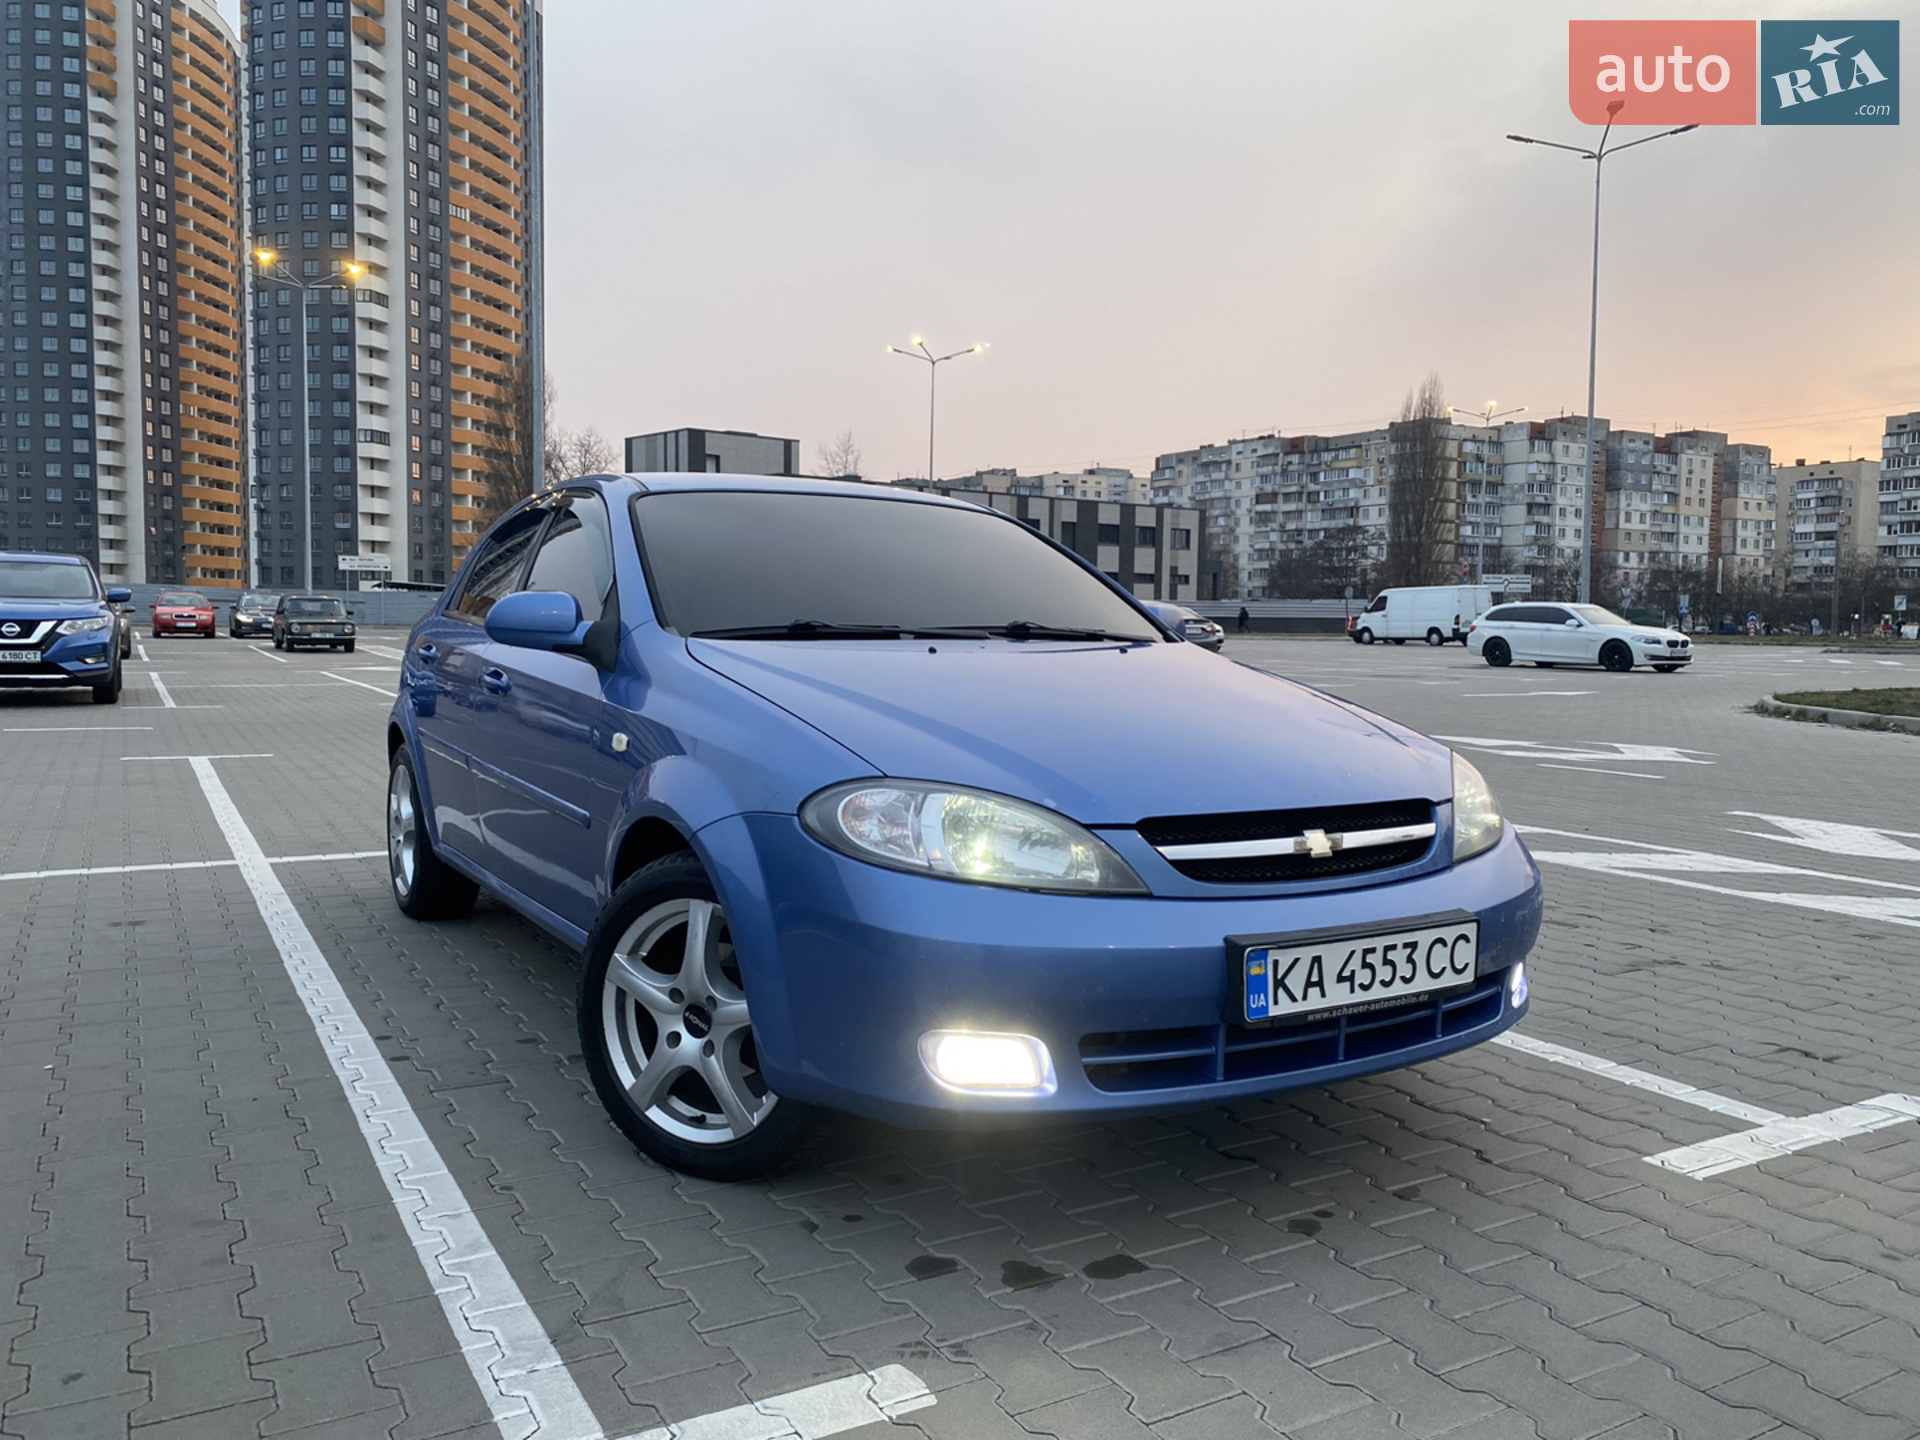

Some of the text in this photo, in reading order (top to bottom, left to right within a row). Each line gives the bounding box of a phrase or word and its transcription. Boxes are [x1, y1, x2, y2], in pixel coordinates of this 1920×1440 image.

[1273, 933, 1471, 1006] KA 4553 CC
[1250, 994, 1267, 1008] UA
[1307, 994, 1429, 1021] www.schauer-automobile.de
